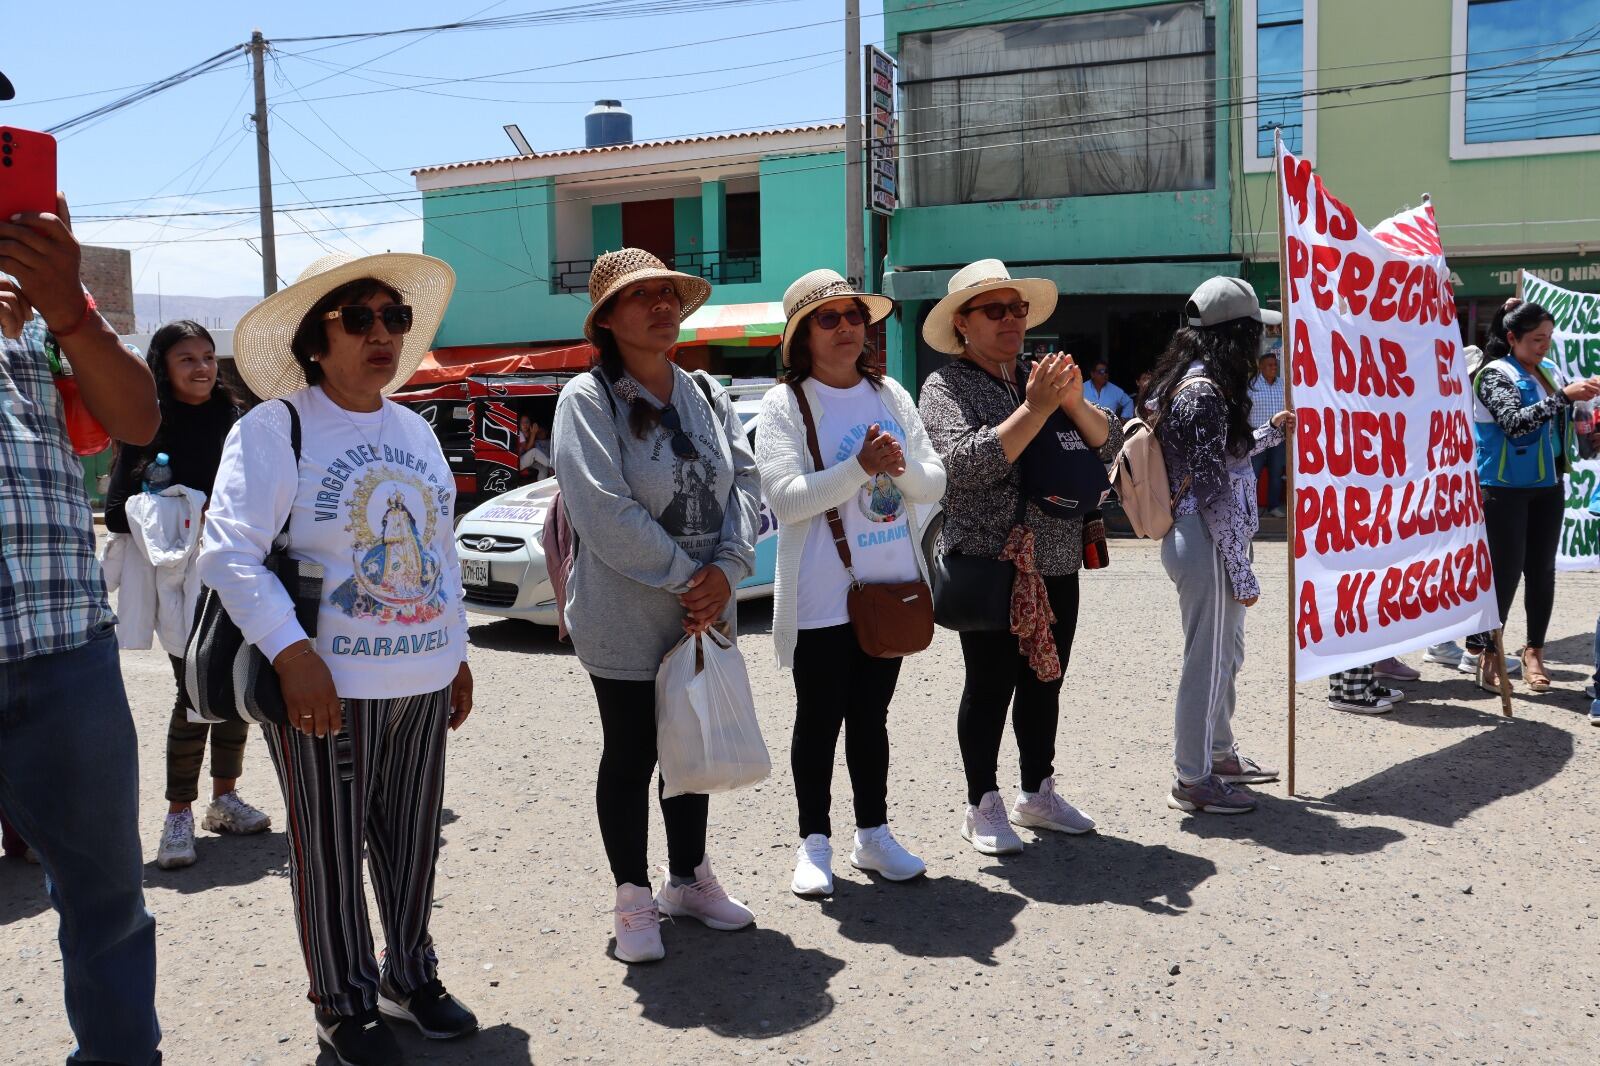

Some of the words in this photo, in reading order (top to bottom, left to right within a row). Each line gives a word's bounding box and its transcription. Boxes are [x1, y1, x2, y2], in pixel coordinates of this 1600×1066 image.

[1284, 155, 1358, 241] MIS
[1287, 235, 1457, 326] PEREGR
[1292, 319, 1318, 387] A
[1331, 330, 1415, 398] DAR
[1435, 338, 1462, 397] EL
[1296, 406, 1407, 478] BUEN
[1427, 409, 1474, 472] PASO
[315, 457, 355, 522] VIRGEN
[345, 443, 382, 467] DEL
[383, 444, 428, 475] BUEN
[428, 472, 451, 516] PASO
[1294, 484, 1393, 559] PARA
[1297, 580, 1323, 650] A
[1334, 571, 1375, 637] MI
[1378, 538, 1492, 627] REGAZO
